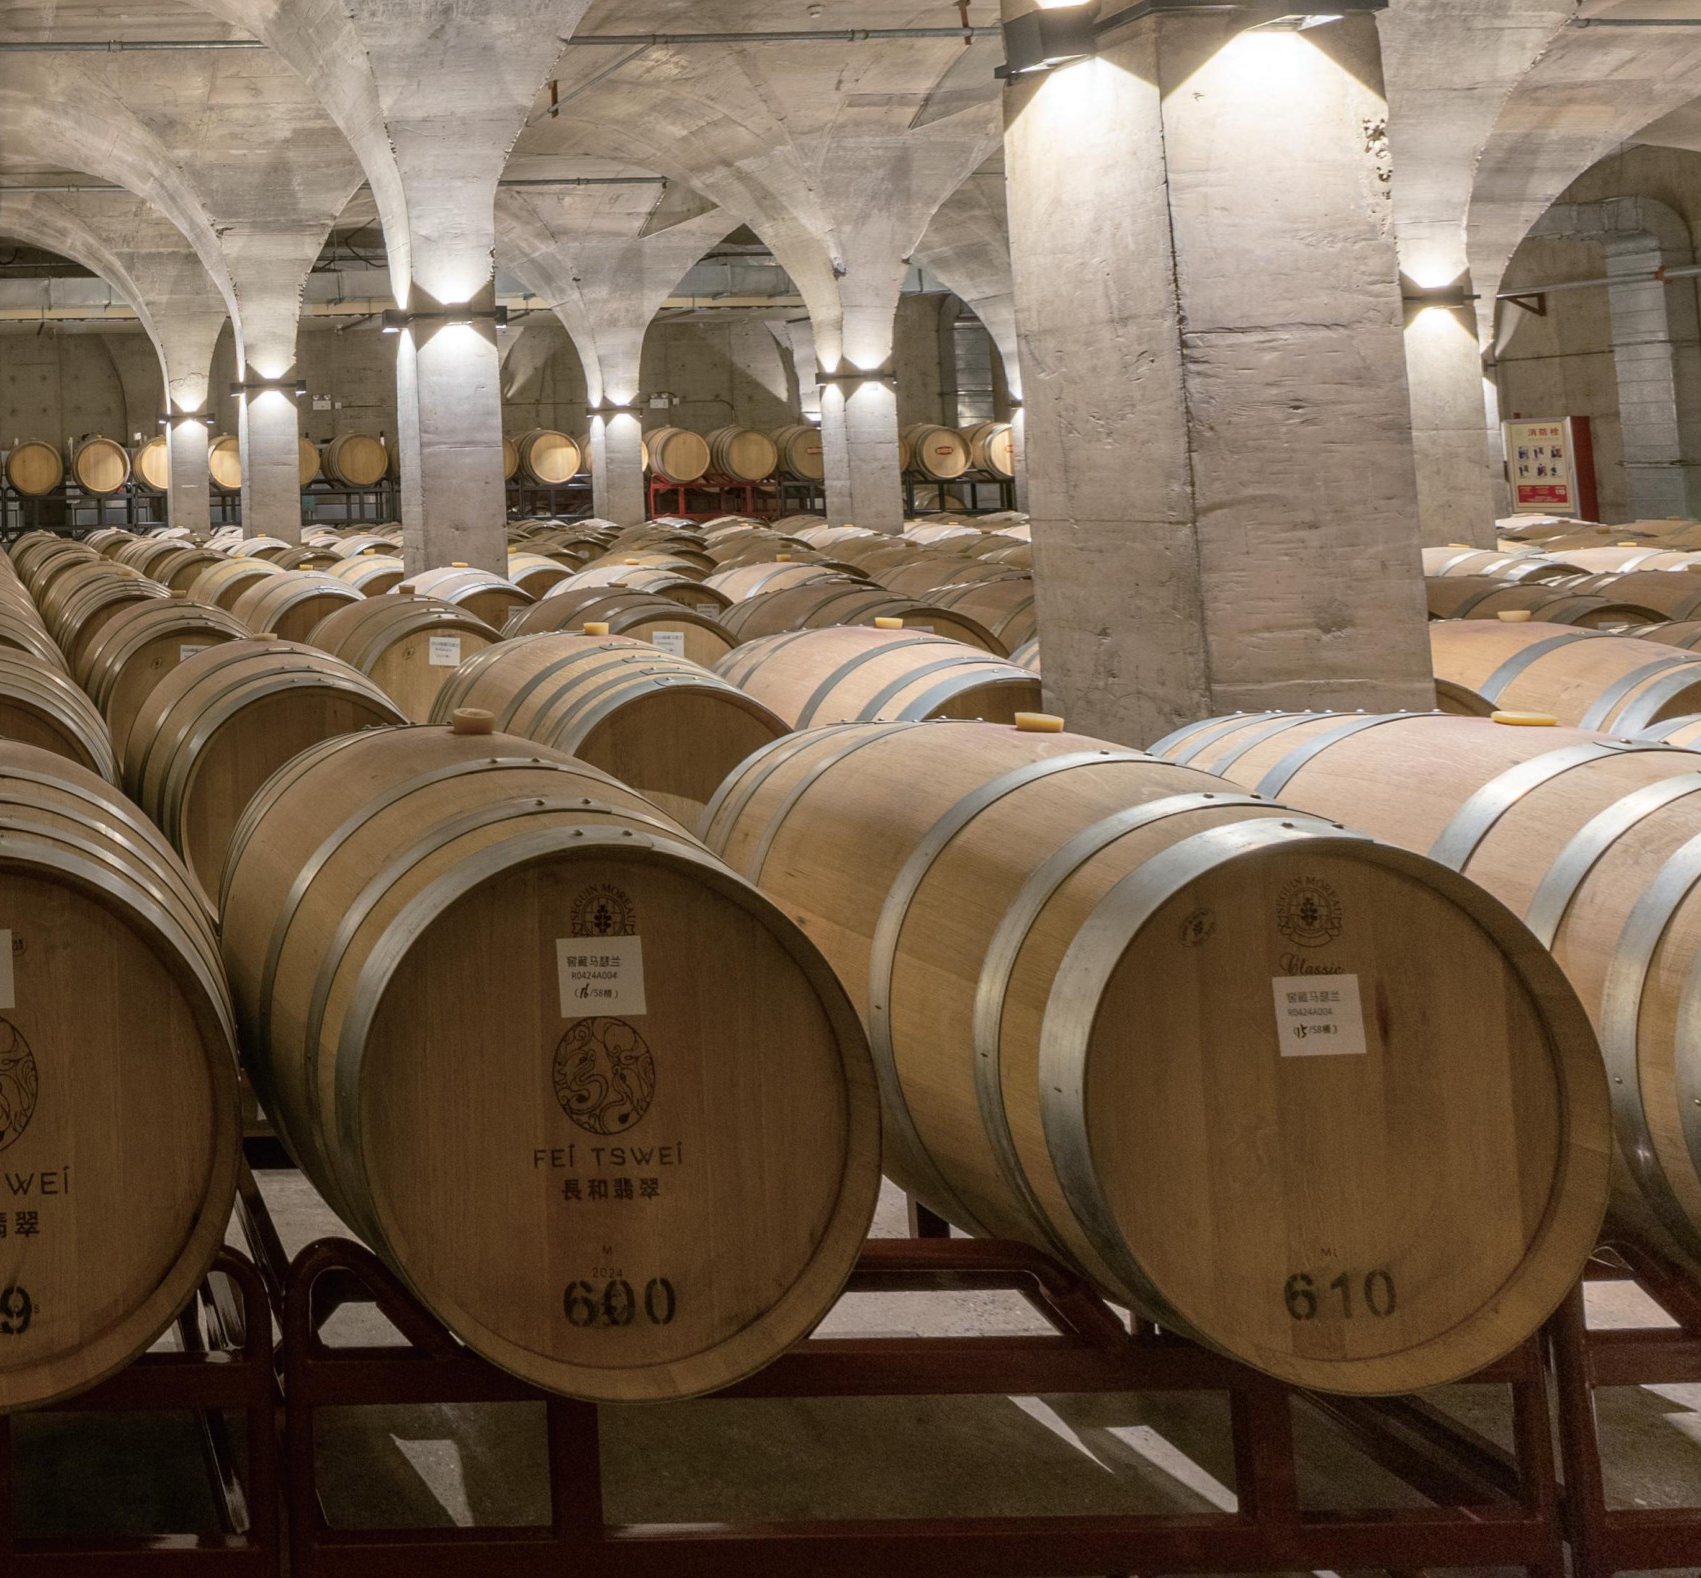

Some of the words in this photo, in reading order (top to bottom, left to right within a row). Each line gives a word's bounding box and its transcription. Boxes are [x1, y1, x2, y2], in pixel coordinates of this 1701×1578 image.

[571, 883, 598, 922] SEGUIN
[602, 883, 636, 924] MOREAU
[1305, 875, 1342, 917] MOREAU
[1280, 952, 1346, 976] Classic
[562, 1176, 660, 1201] 長和翡翠
[563, 1277, 677, 1328] 600
[1284, 1269, 1397, 1321] 610
